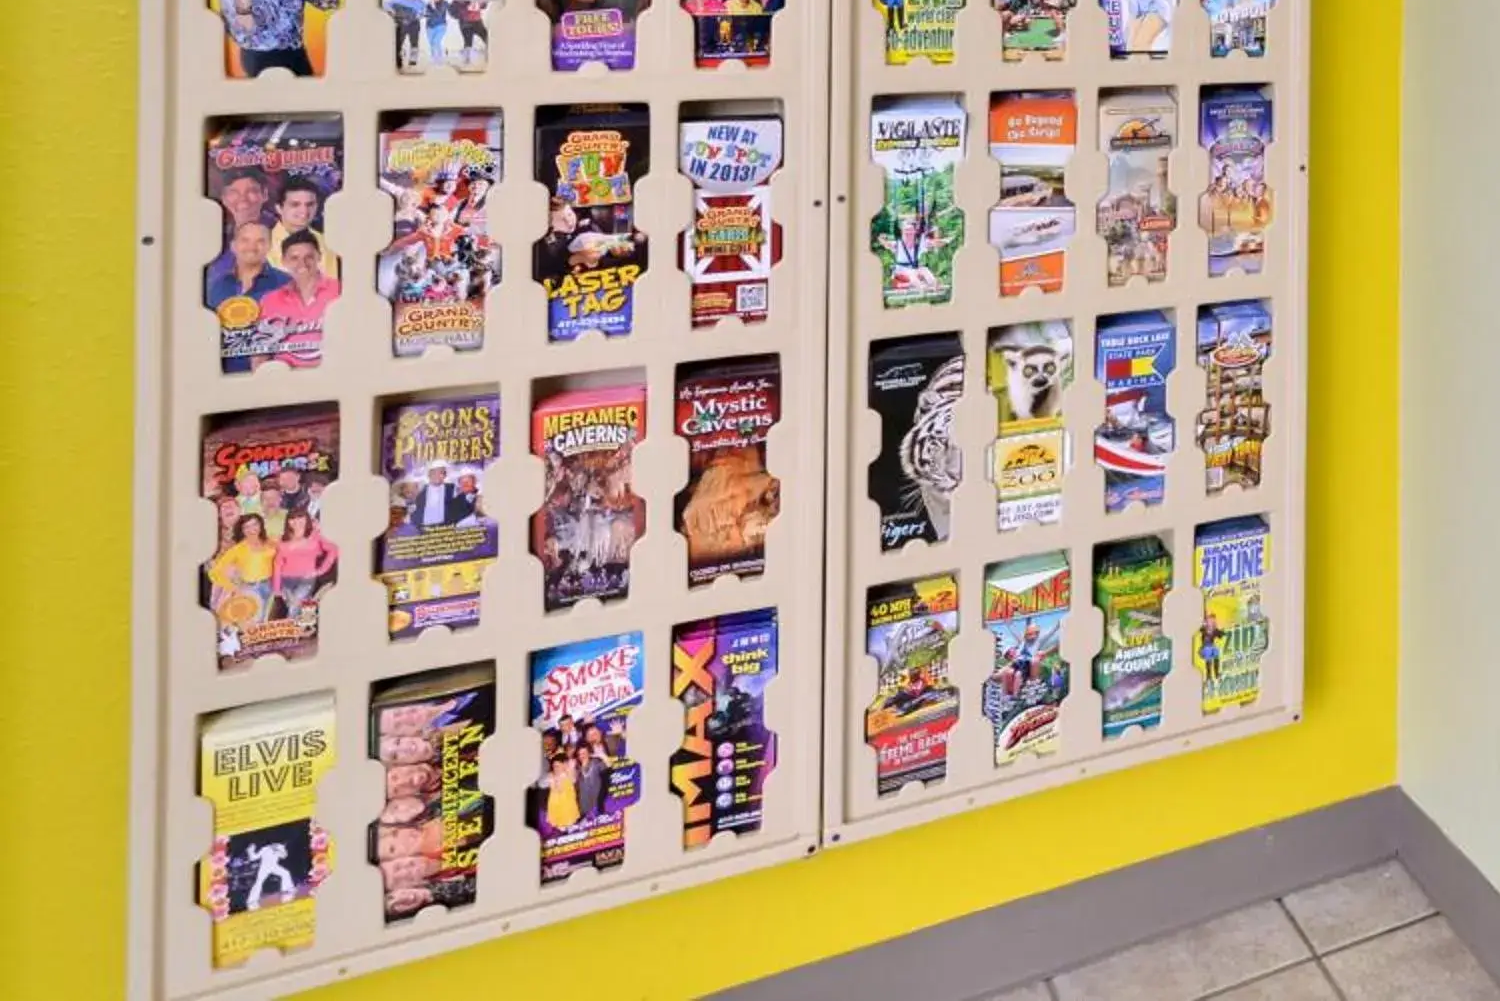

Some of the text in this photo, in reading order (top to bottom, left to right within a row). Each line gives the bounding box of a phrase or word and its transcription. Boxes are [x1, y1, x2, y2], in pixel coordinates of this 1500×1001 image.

[707, 125, 759, 145] NEW AT
[877, 117, 961, 139] VIGILANTE
[689, 157, 758, 181] IN 2013!
[544, 264, 640, 298] LASER
[408, 306, 469, 321] GRAND
[562, 288, 627, 318] TAG
[425, 406, 491, 437] SONS
[543, 405, 640, 439] MERAMEC
[681, 412, 773, 435] Caverns
[692, 393, 767, 420] Mystic
[393, 430, 494, 468] PIONEERS
[553, 425, 628, 451] CAVERNS
[1201, 547, 1264, 588] ZIPLINE
[544, 644, 639, 696] SMOKE
[720, 649, 769, 665] think
[543, 682, 635, 721] MOUNTAIN
[213, 728, 328, 777] ELVIS
[671, 638, 713, 850] IMAX
[228, 761, 314, 802] LIVE
[458, 720, 484, 869] SEVEN
[441, 734, 459, 869] MAGNIFICENT
